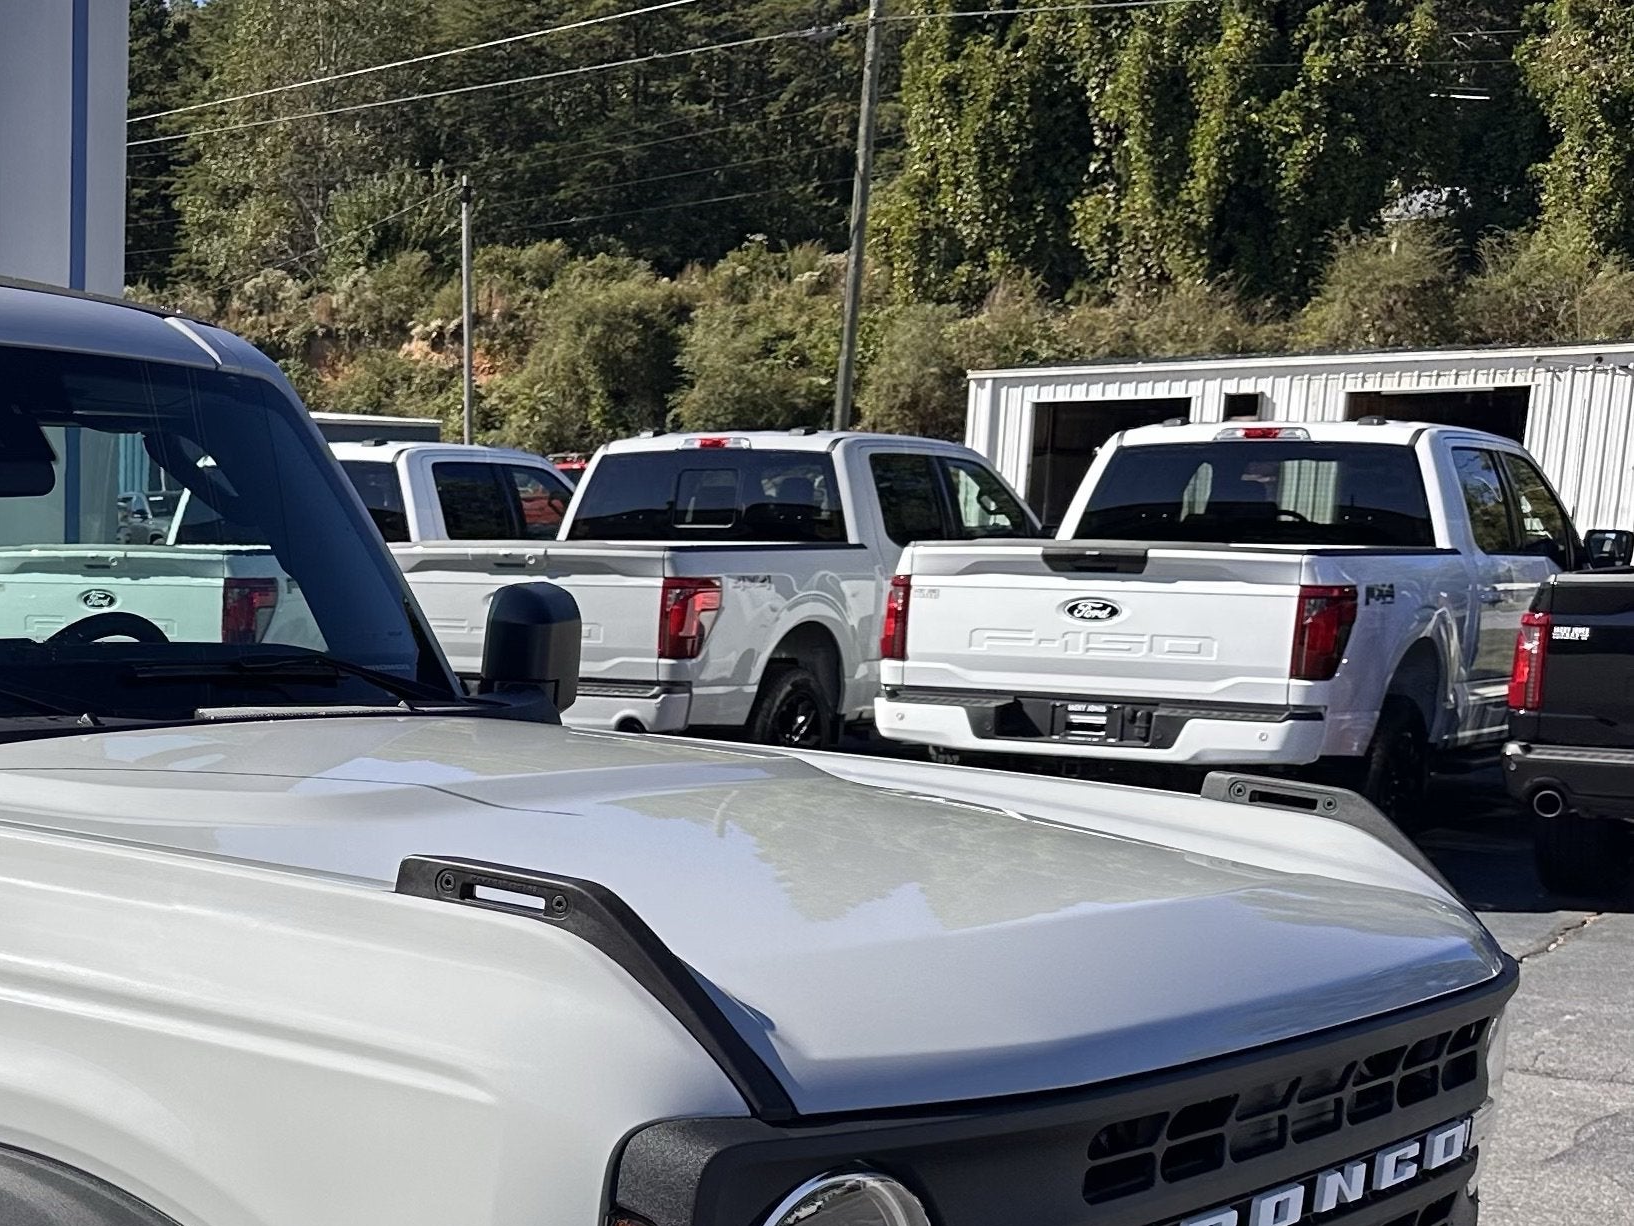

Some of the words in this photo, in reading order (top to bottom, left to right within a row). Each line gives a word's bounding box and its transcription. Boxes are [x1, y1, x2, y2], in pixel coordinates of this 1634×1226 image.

[85, 589, 112, 607] Ford
[1073, 602, 1113, 620] Ford
[968, 627, 1219, 661] F-150
